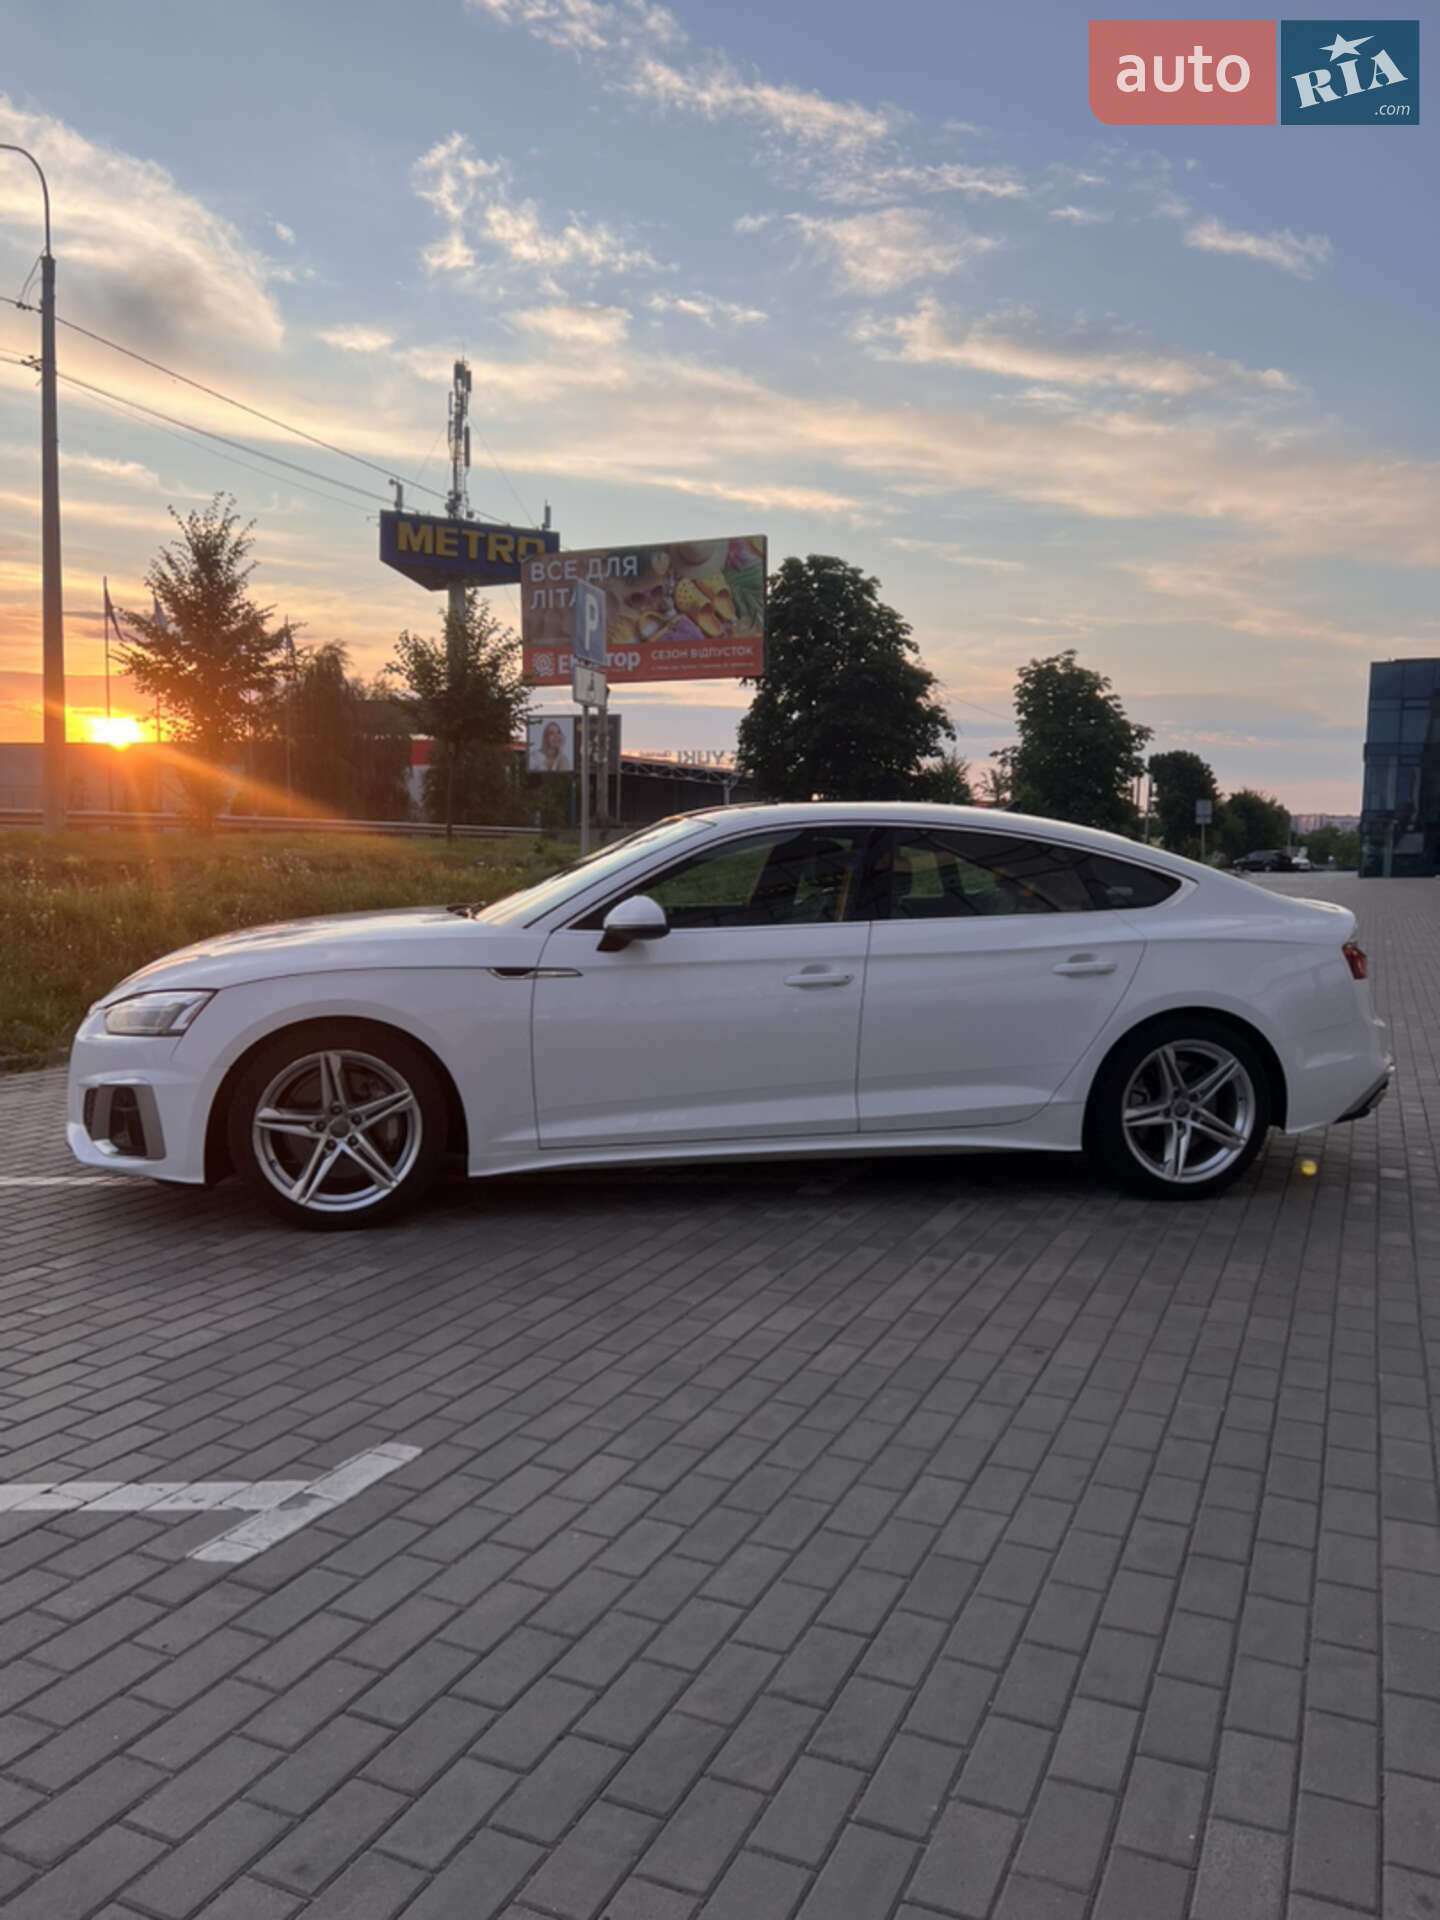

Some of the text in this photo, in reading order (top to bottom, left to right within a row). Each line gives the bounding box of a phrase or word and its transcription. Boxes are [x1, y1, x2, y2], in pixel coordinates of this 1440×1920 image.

[397, 521, 545, 564] METRO
[530, 556, 637, 582] ВСЕ ДЛЯ
[585, 593, 599, 651] P
[651, 650, 688, 660] СЕЗОН
